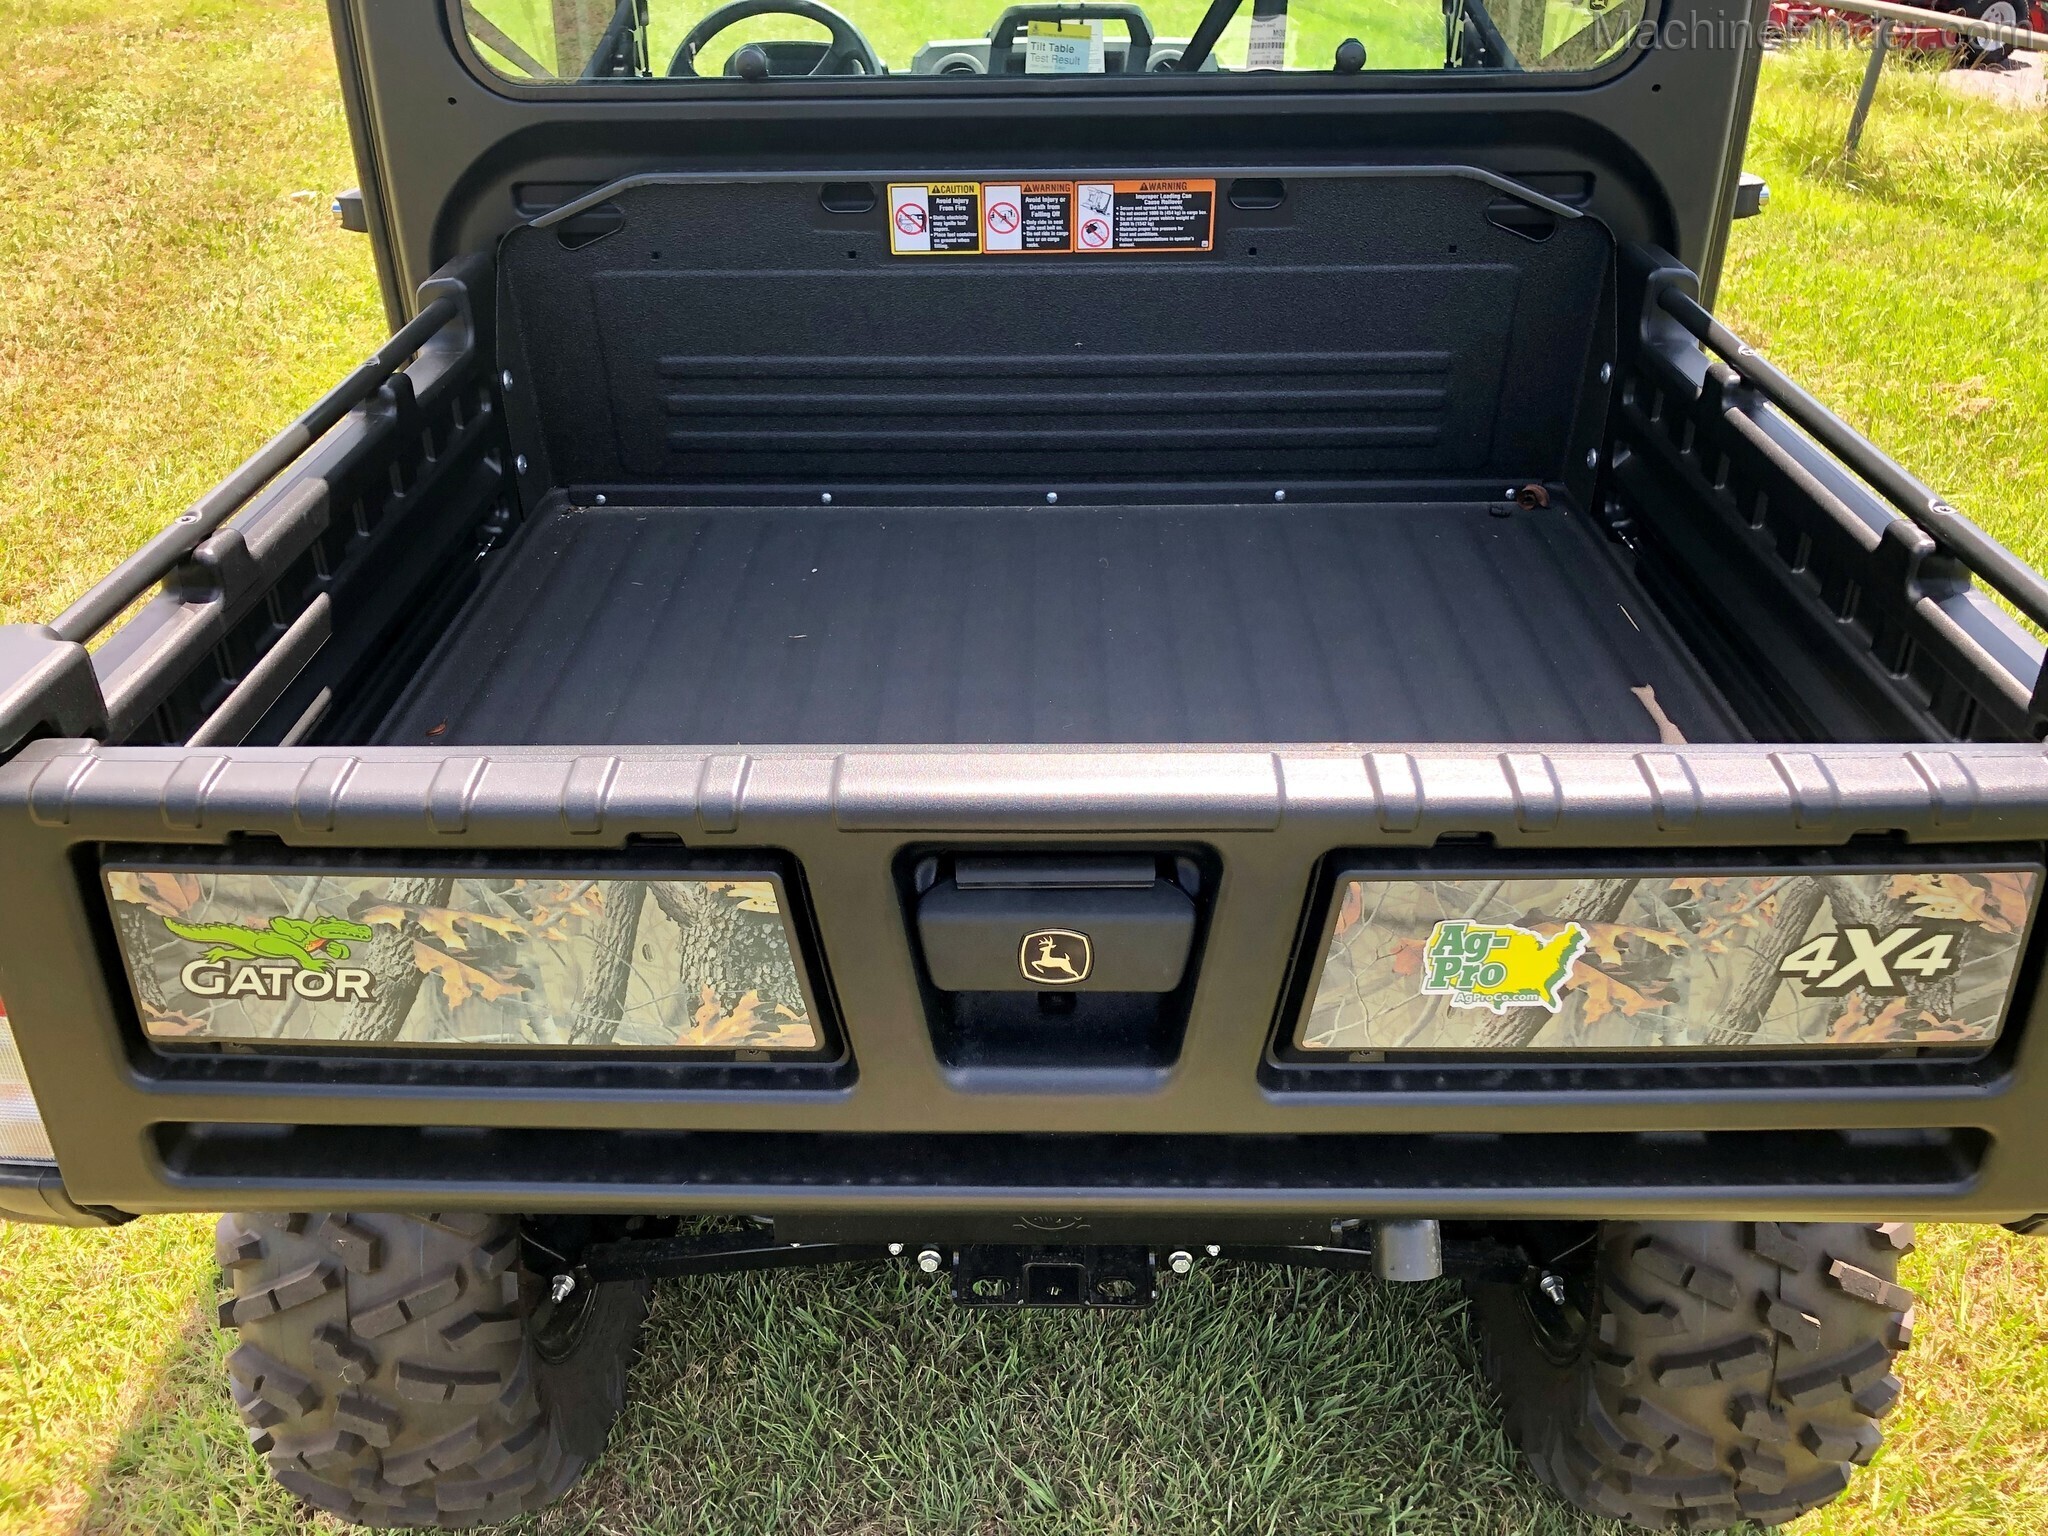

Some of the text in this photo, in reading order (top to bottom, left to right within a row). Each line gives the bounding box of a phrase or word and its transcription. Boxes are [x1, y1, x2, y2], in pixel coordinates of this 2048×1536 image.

[1031, 42, 1075, 53] Tilt Table
[1030, 53, 1049, 63] Test
[1052, 54, 1080, 65] Result
[1032, 184, 1070, 192] WARNING
[1149, 182, 1187, 190] WARNING
[1431, 923, 1512, 963] Ag-
[1777, 926, 1956, 990] 4X4
[1426, 956, 1507, 990] Pro
[180, 959, 376, 1001] GATOR
[1454, 992, 1540, 1004] AgProCo.com
